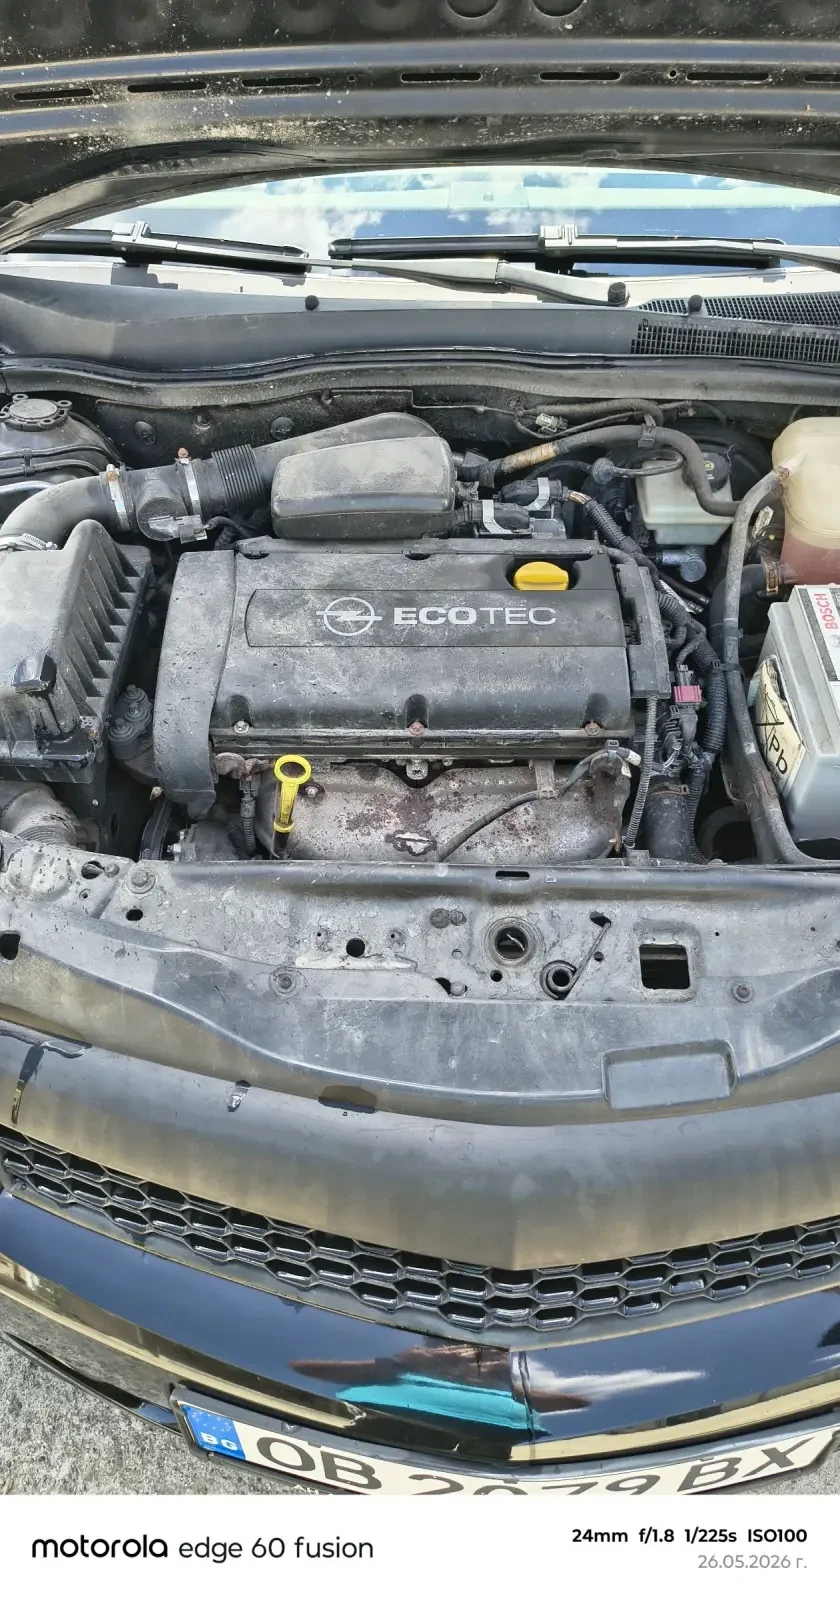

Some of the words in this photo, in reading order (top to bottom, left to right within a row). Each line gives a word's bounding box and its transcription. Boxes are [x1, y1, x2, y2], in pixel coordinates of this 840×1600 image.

[393, 606, 557, 625] ECOTEC
[814, 593, 839, 630] BOSCH
[769, 733, 788, 775] Pb
[200, 1431, 239, 1452] BG
[256, 1436, 382, 1490] OB
[677, 1437, 815, 1492] BX
